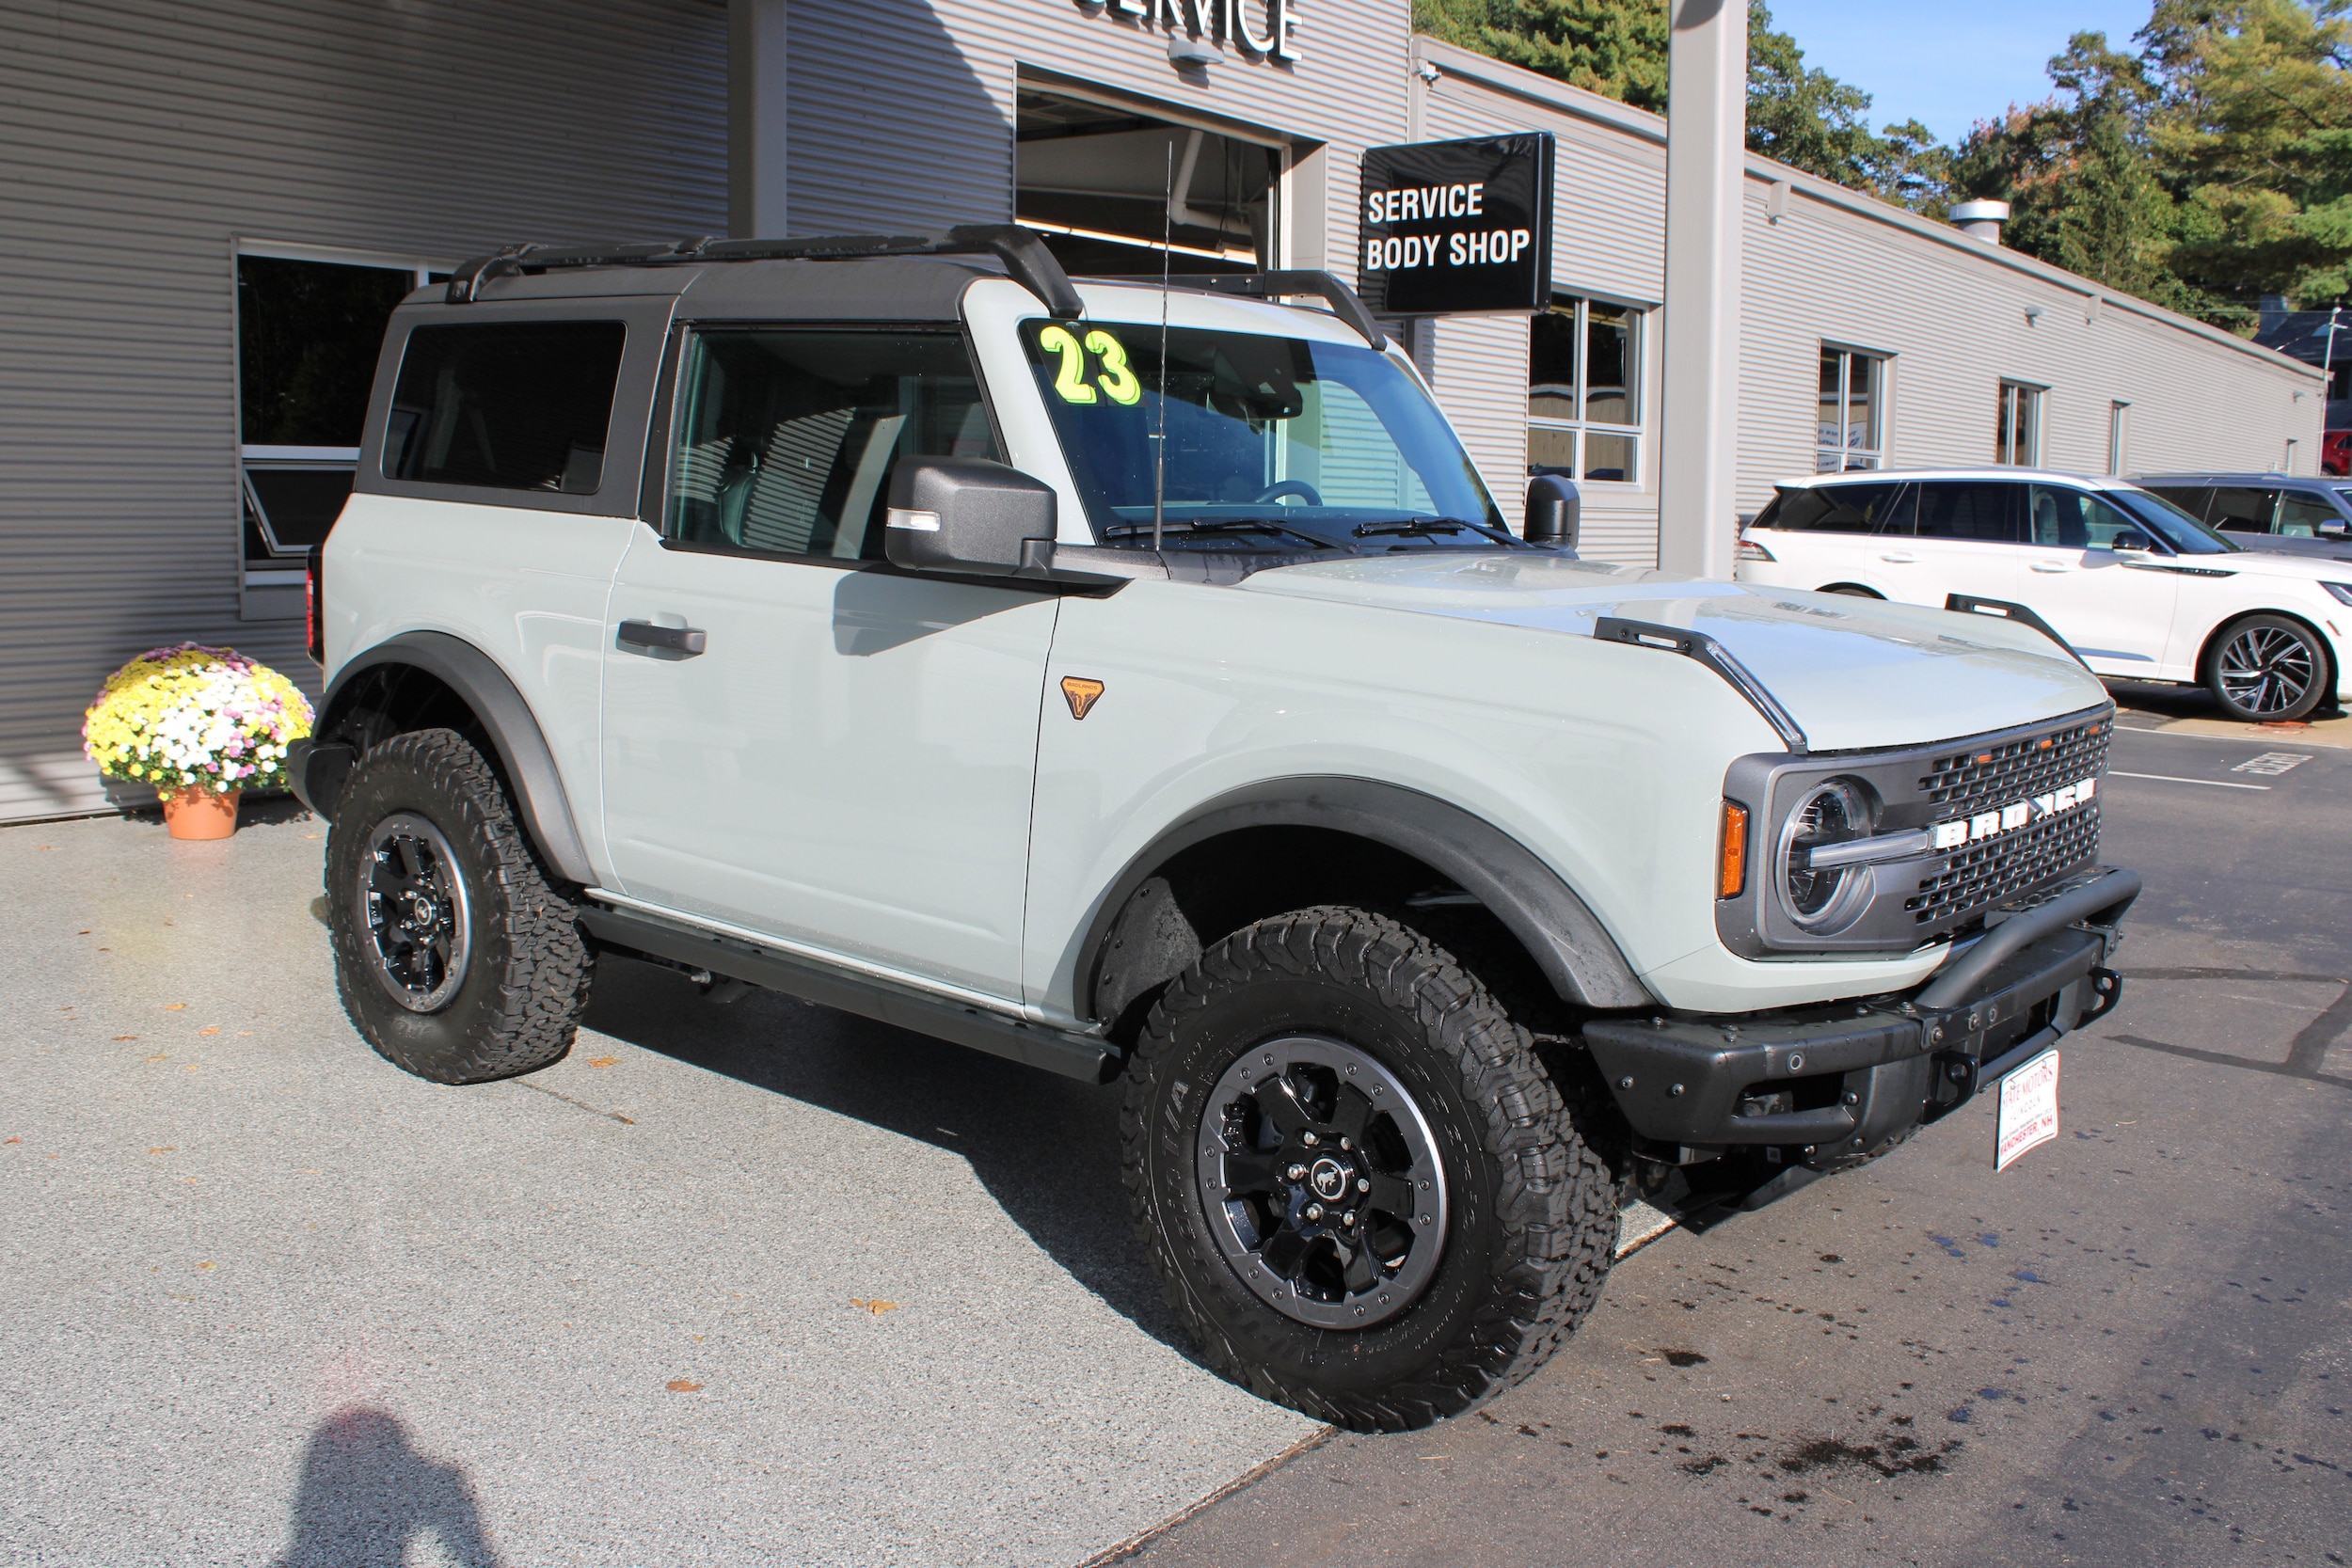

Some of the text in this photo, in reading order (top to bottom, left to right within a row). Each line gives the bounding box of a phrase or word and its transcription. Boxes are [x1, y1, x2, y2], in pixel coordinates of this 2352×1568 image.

[1078, 0, 1303, 62] VICE
[1368, 183, 1484, 223] SERVICE
[1367, 229, 1531, 271] BODY SHOP
[1040, 325, 1141, 405] 23
[2022, 1065, 2053, 1094] MOTORS
[2041, 1115, 2053, 1128] NH
